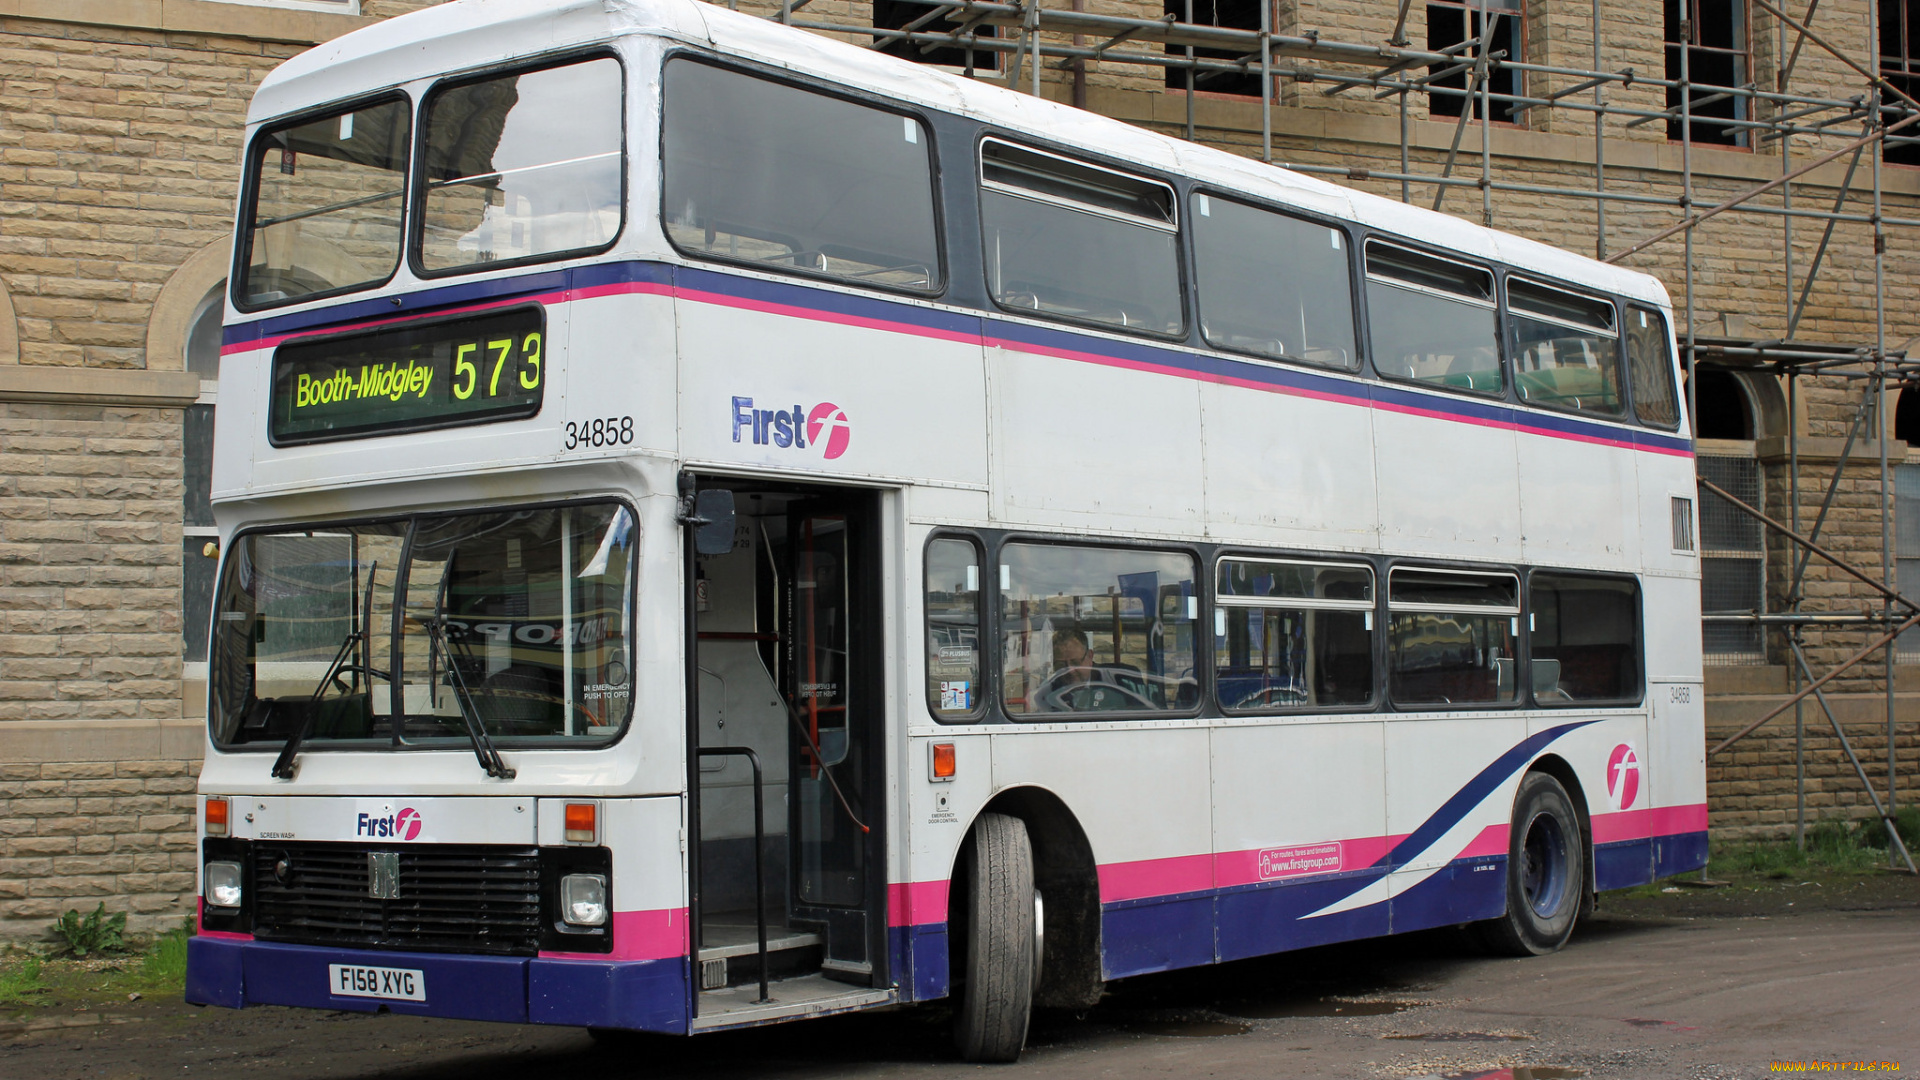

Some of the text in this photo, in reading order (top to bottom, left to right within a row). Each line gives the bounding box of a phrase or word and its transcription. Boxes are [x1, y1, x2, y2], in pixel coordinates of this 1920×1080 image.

[296, 332, 541, 408] Booth-Midgley 573
[565, 416, 634, 450] 34858
[732, 396, 805, 448] First
[584, 692, 602, 700] PUSH
[1671, 686, 1690, 704] 34858
[357, 813, 395, 838] First
[1316, 846, 1336, 854] timetables
[1271, 856, 1338, 872] www.firstgroup.com
[341, 967, 415, 996] F158 XYG
